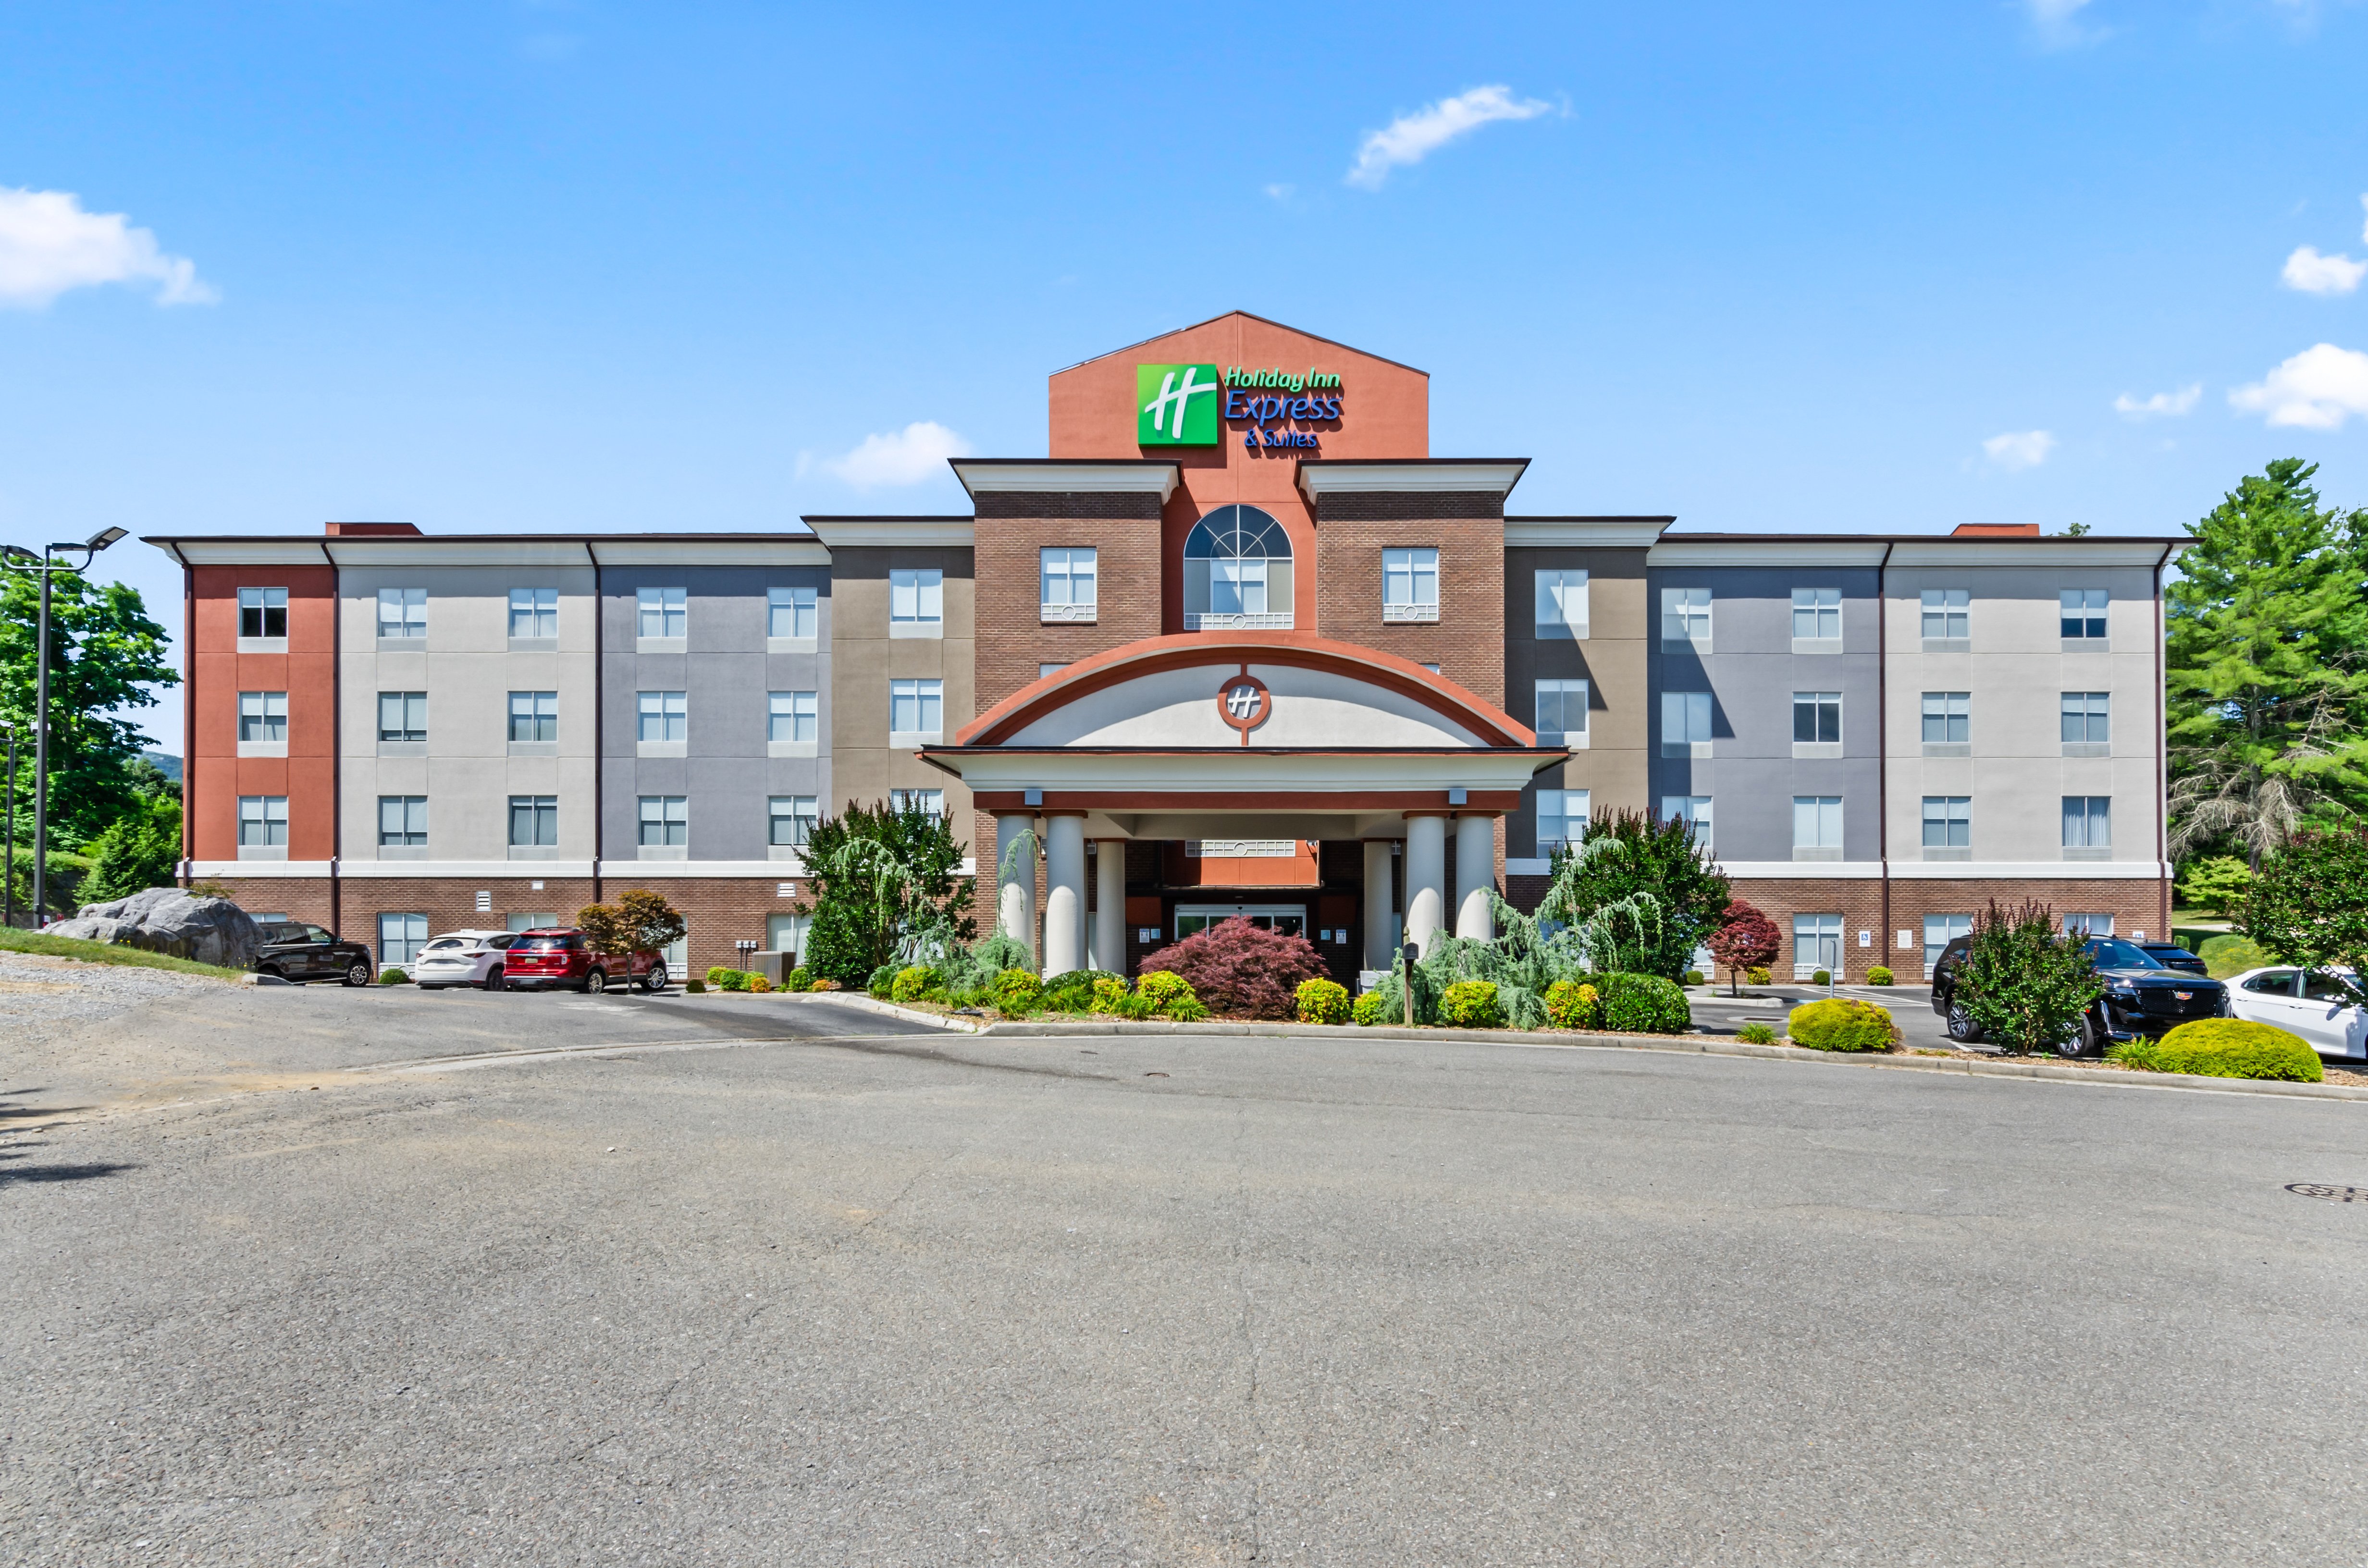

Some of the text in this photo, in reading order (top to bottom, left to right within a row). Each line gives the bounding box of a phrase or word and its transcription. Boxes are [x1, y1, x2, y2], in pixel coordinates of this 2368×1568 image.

[1224, 366, 1340, 392] Holiday Inn
[1145, 368, 1217, 439] H
[1224, 390, 1340, 427] Express
[1244, 429, 1317, 447] & Suites
